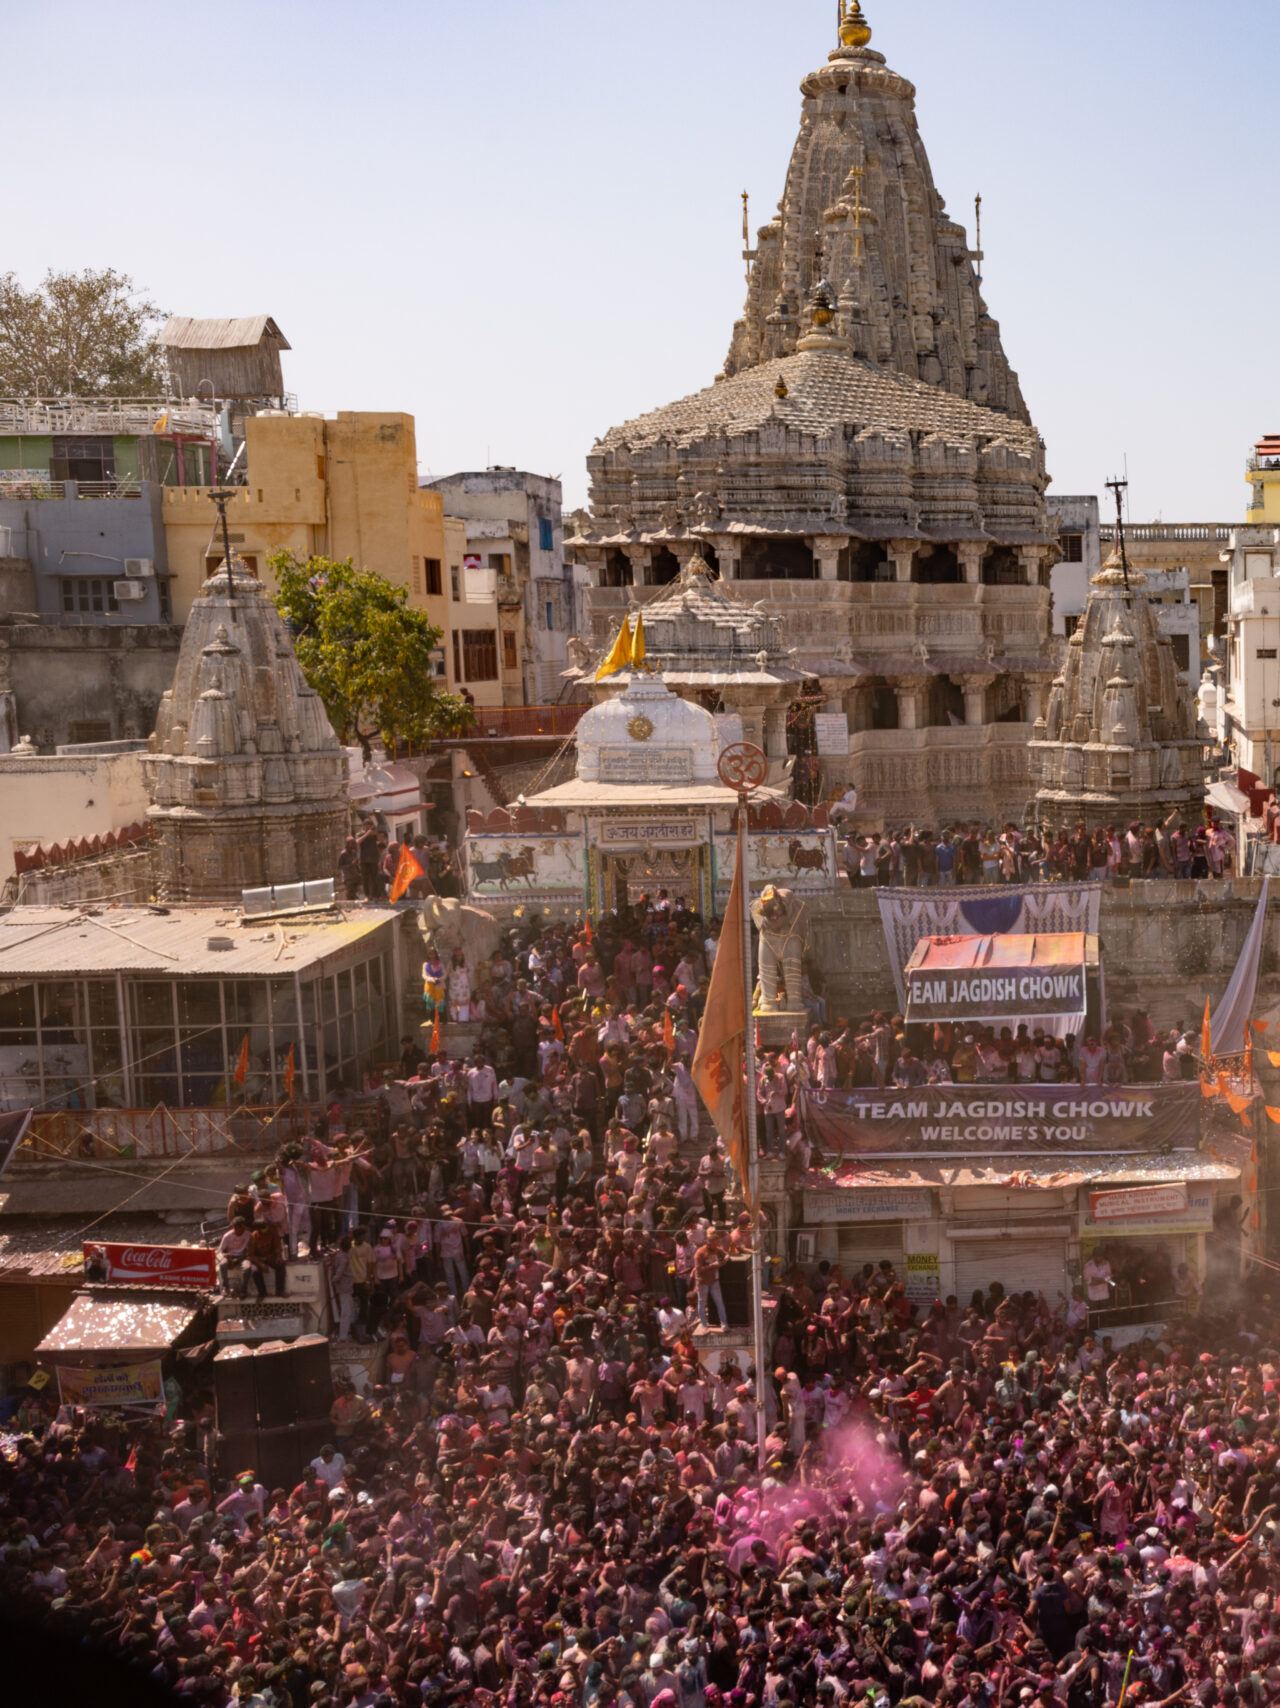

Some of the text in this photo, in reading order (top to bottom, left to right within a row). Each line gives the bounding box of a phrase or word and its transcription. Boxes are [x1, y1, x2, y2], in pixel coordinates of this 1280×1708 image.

[911, 975, 1081, 1004] EAM JAGDISH CHOWK
[855, 1100, 1155, 1119] TEAM JAGDISH CHOWK
[921, 1126, 1087, 1141] WELCOME'S YOU
[907, 1256, 938, 1264] MONEY
